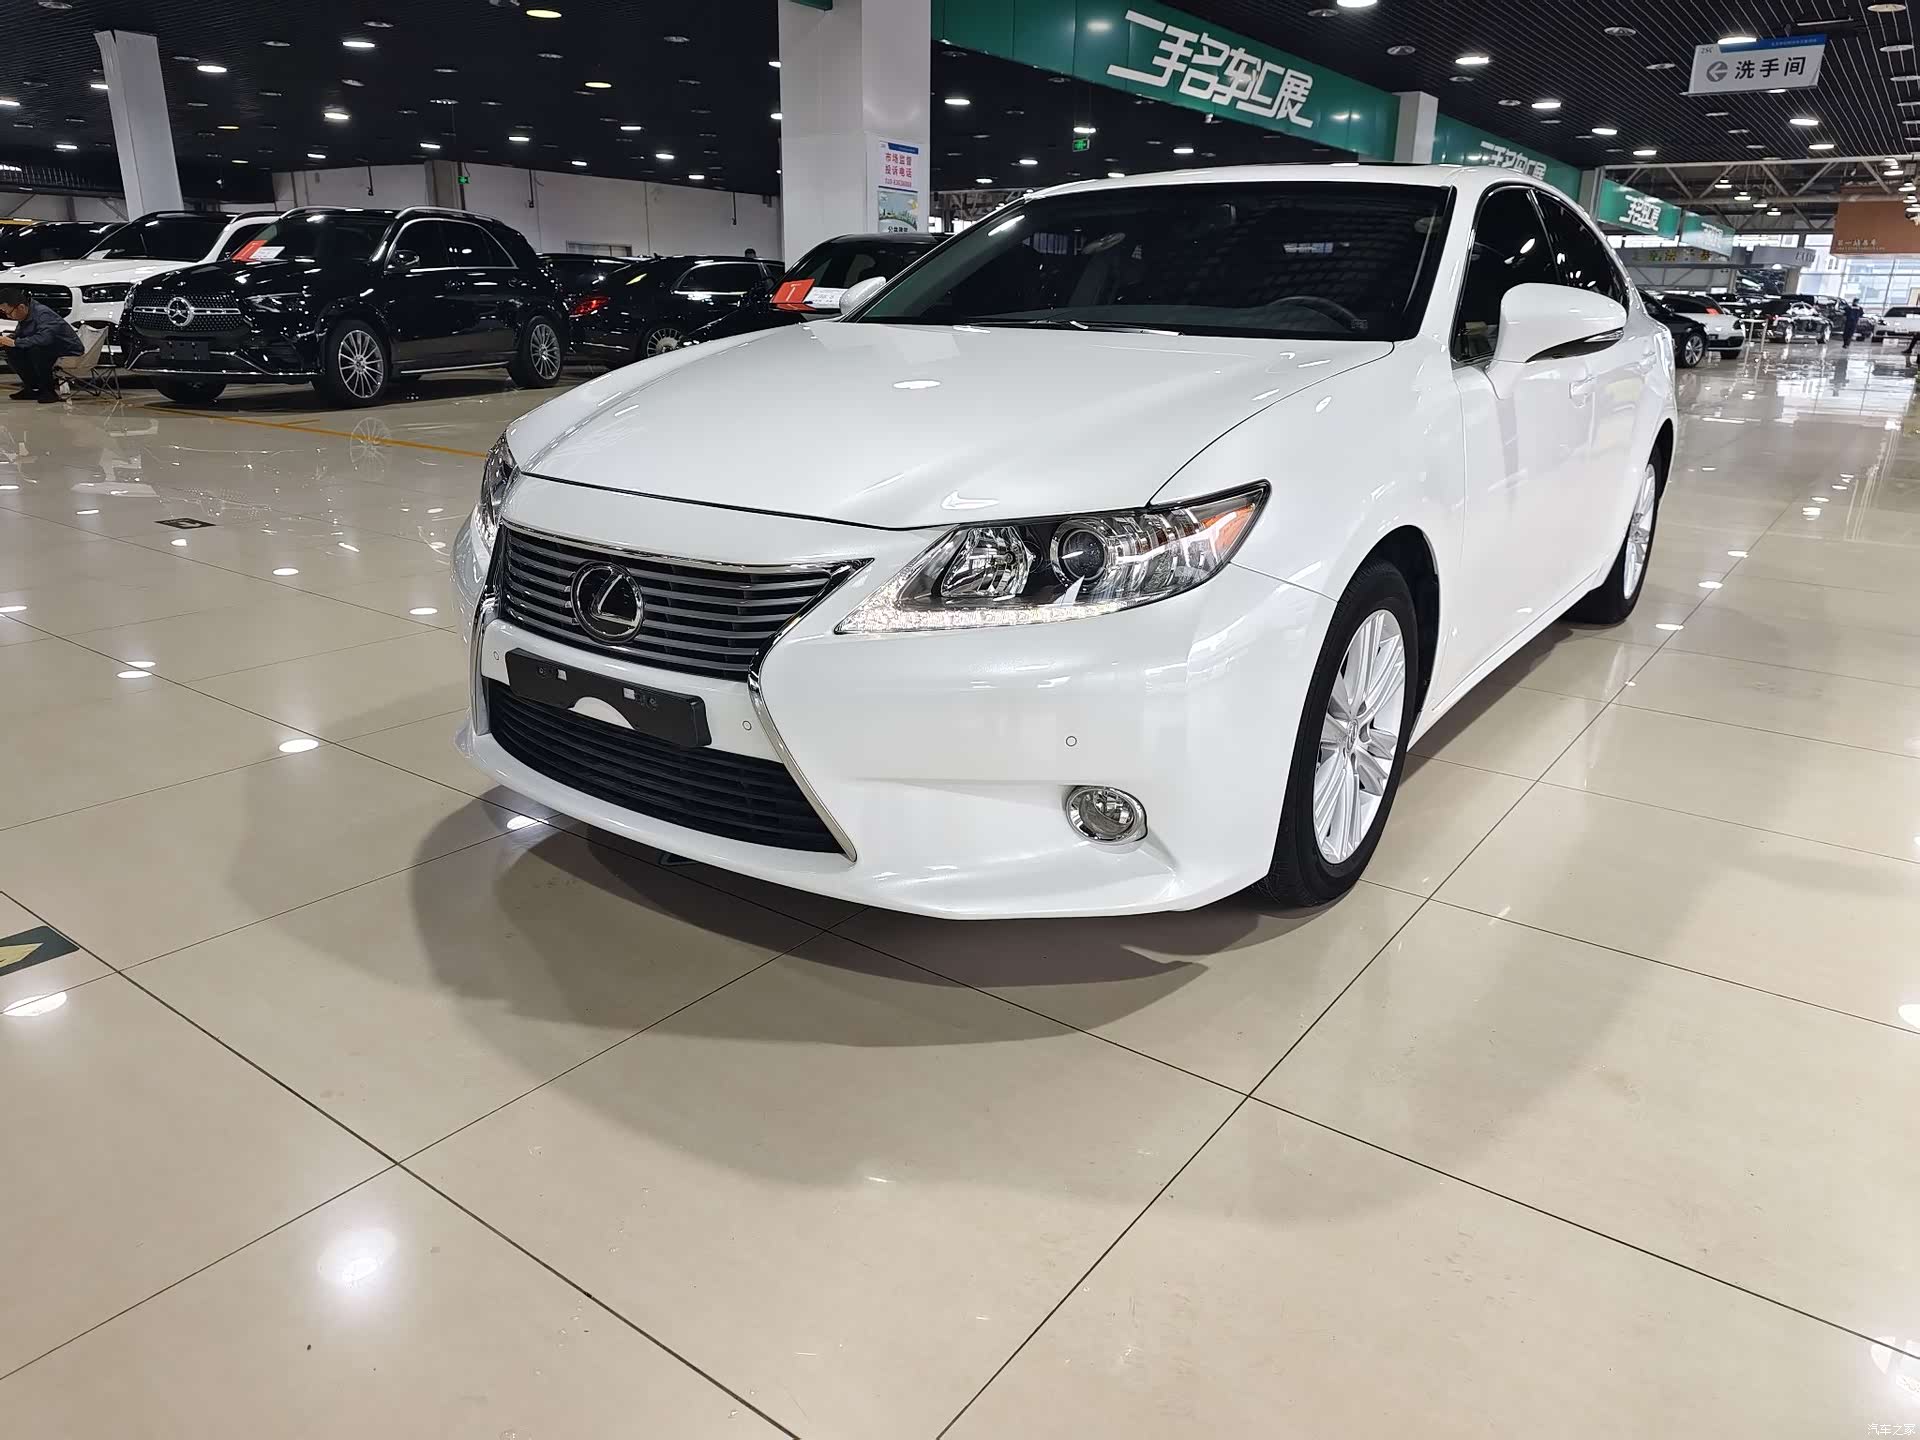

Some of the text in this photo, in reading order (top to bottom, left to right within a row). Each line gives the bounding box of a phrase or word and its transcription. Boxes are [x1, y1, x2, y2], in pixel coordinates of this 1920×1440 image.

[1106, 9, 1314, 129] 二手名车汇展
[1734, 56, 1806, 80] 洗手间
